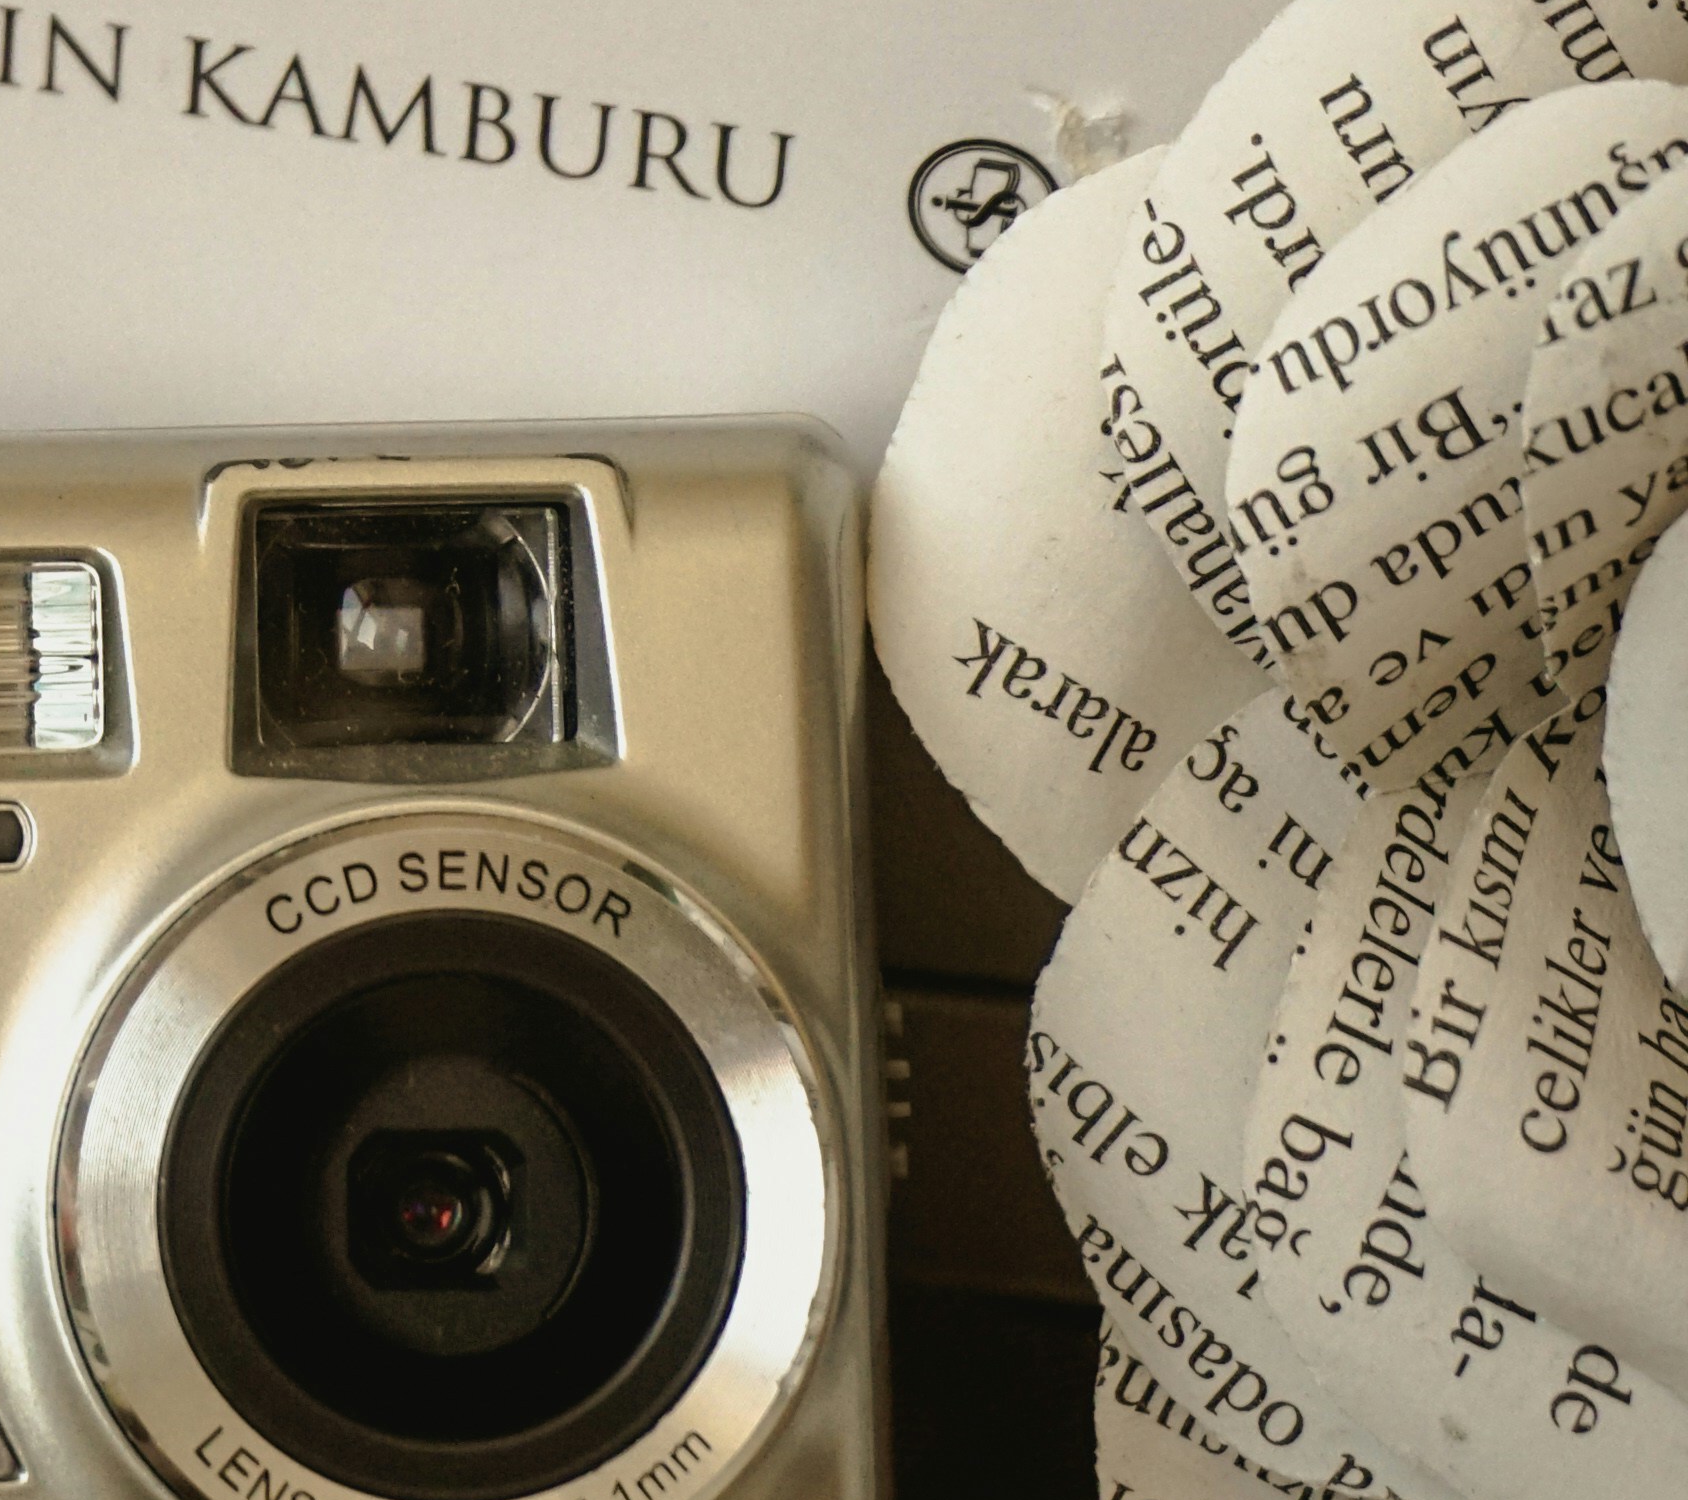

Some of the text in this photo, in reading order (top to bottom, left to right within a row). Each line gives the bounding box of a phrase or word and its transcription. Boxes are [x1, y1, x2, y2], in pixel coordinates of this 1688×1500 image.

[180, 35, 794, 208] KAMBURU
[952, 617, 1158, 774] alarak
[1367, 626, 1454, 687] ve
[264, 850, 633, 938] CCD SENSOR
[1258, 811, 1333, 891] ni
[1438, 785, 1540, 972] kısmı
[1520, 905, 1612, 1155] celikler
[1076, 1213, 1305, 1447] odasına
[1550, 1344, 1632, 1434] de
